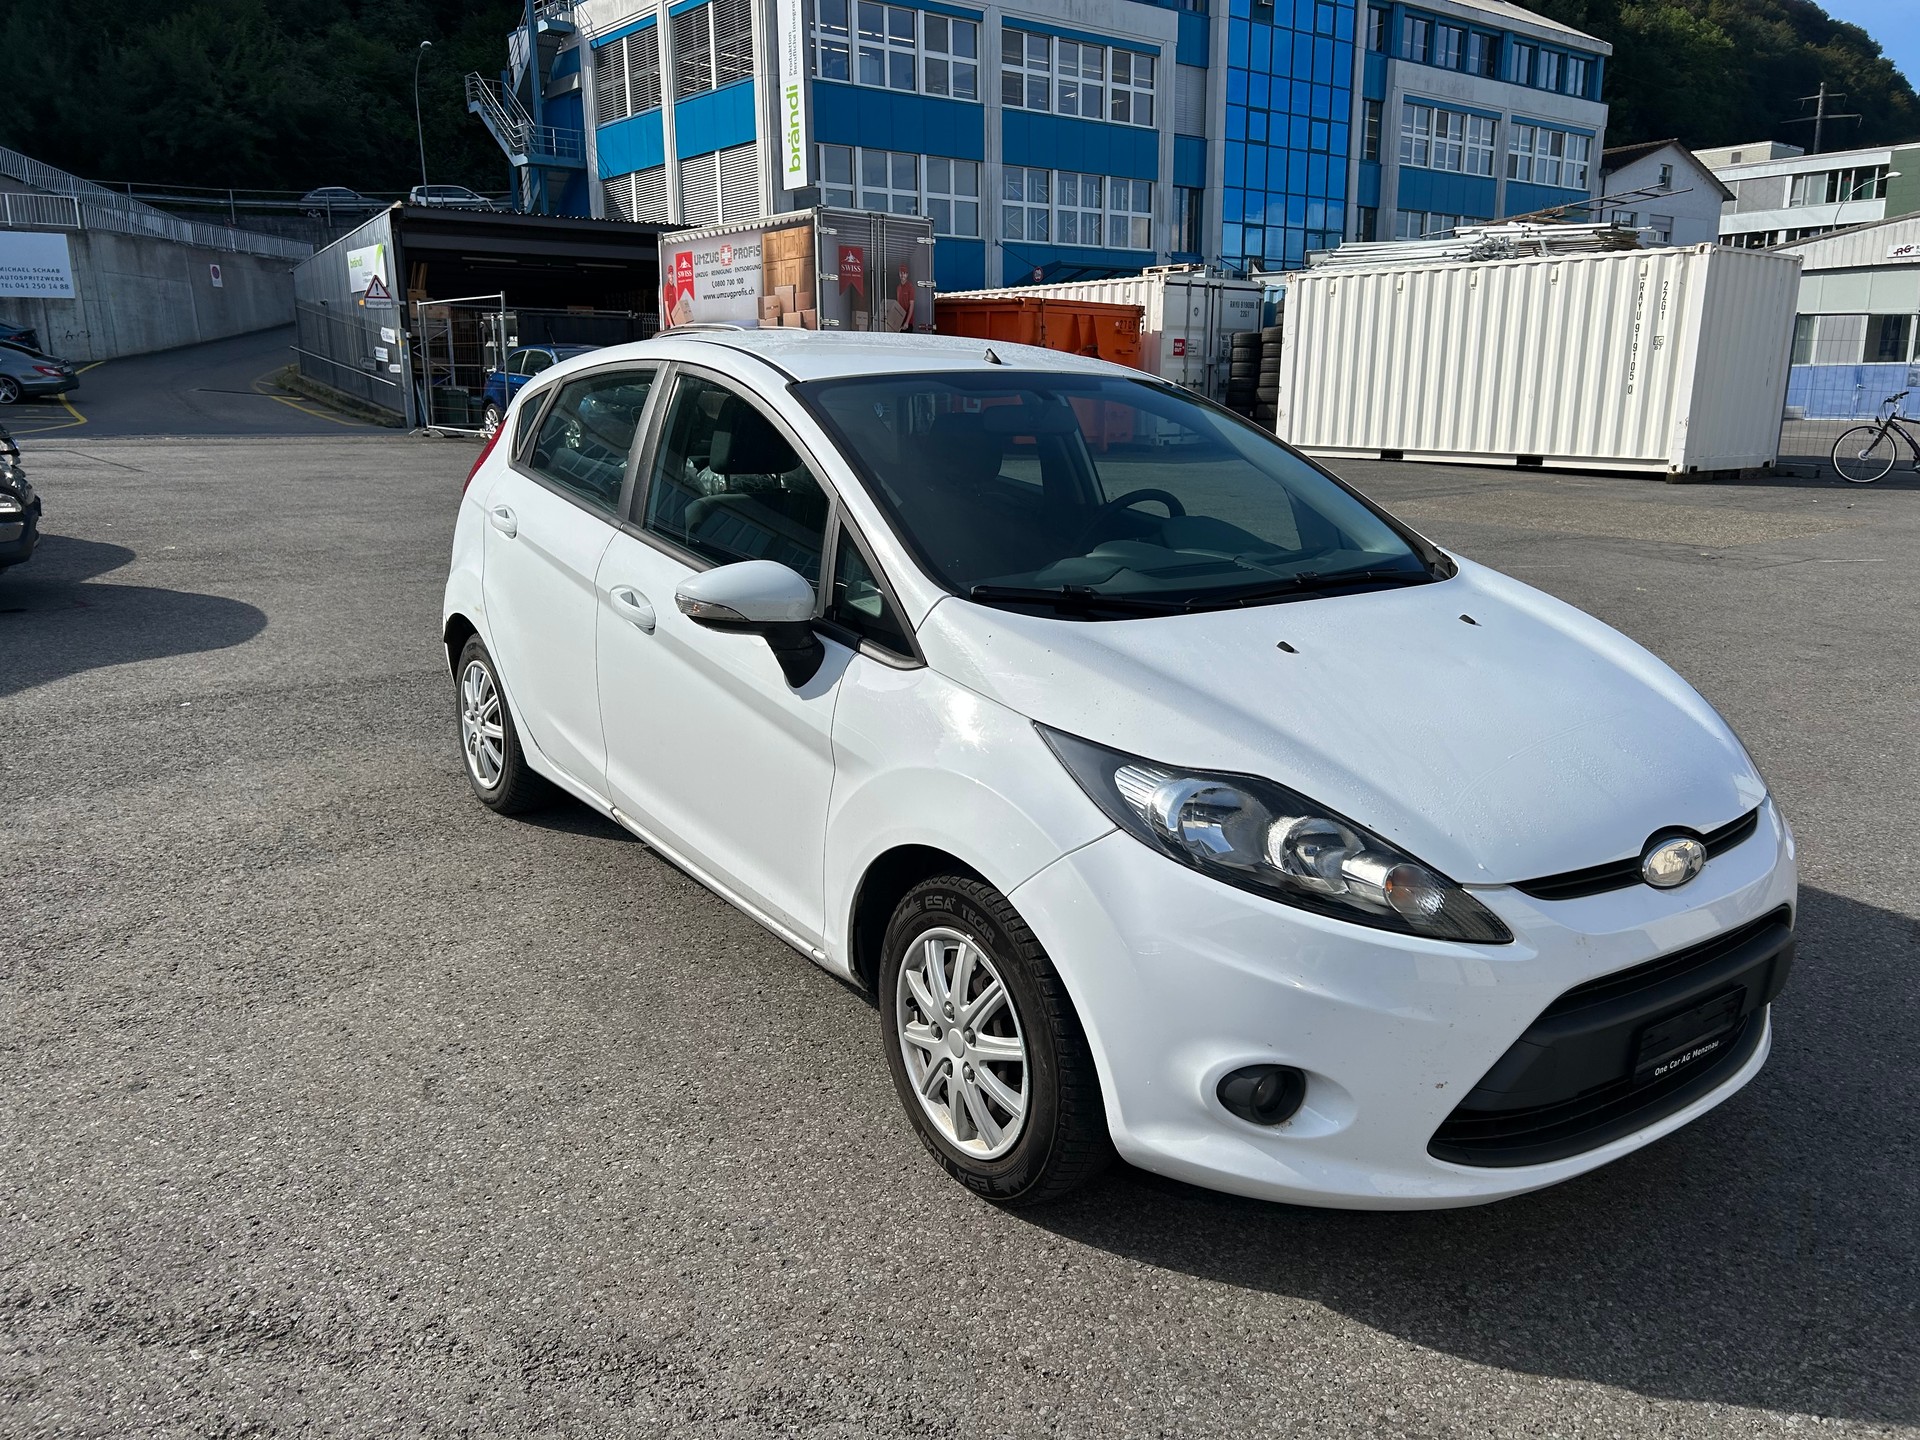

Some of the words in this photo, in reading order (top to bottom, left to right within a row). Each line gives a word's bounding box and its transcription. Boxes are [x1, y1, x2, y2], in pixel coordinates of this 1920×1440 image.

[786, 84, 801, 173] brändi
[694, 251, 720, 265] UMZUG
[733, 244, 761, 260] PROFIS
[841, 264, 862, 273] SWISS
[677, 270, 693, 278] SWISS
[703, 287, 755, 300] www.umzugprofis.ch
[1636, 281, 1645, 320] RAYU
[1660, 281, 1669, 320] 22G1
[962, 904, 995, 944] TECAR
[1655, 1065, 1668, 1076] One
[1669, 1058, 1680, 1069] Car
[1681, 1052, 1691, 1063] AG
[1692, 1040, 1719, 1058] Menznau
